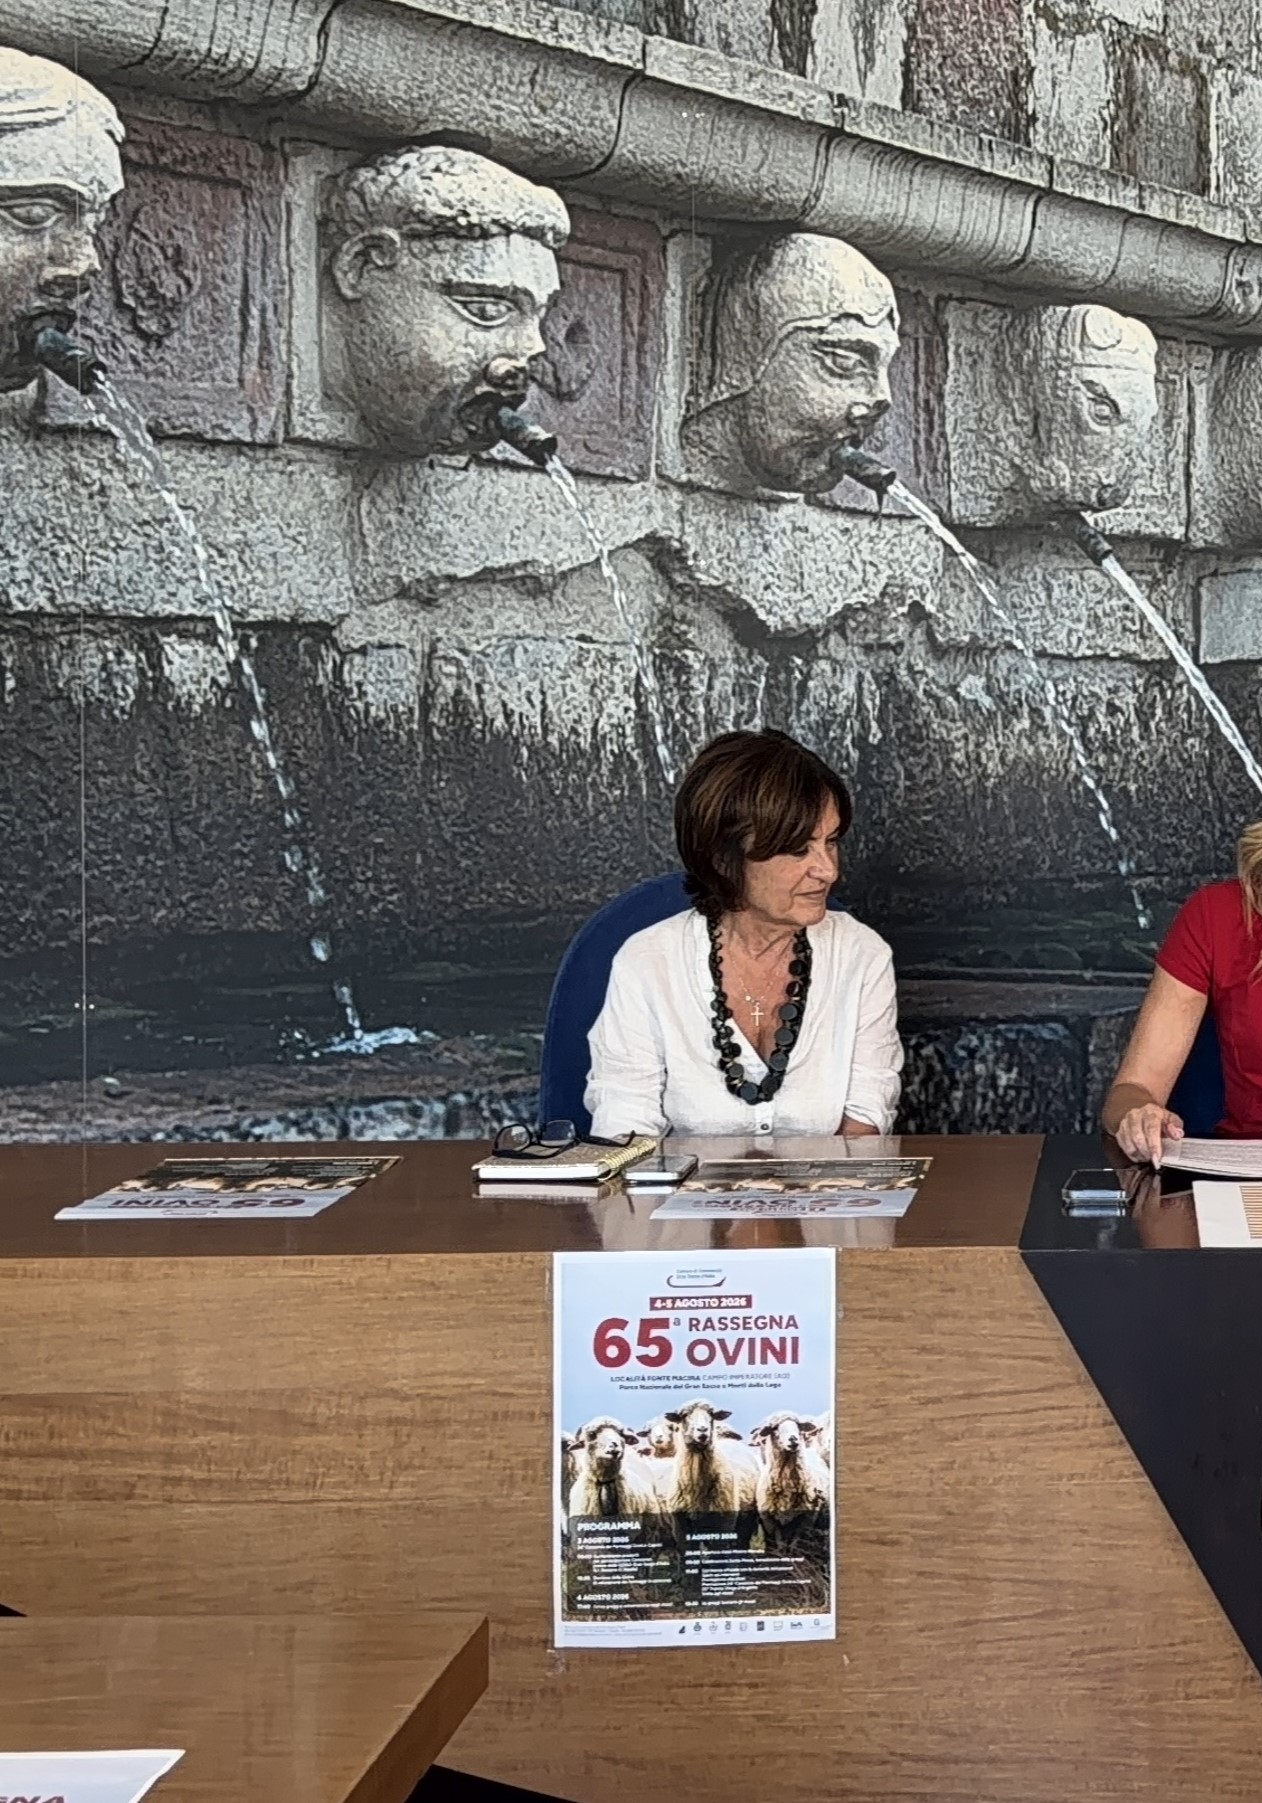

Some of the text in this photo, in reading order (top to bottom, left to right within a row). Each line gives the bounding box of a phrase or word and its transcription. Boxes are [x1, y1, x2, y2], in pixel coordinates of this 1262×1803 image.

[674, 1298, 719, 1308] AGOSTO
[720, 1297, 747, 1307] 2026
[688, 1315, 799, 1332] RASSEGNA
[686, 1336, 799, 1367] OVINI
[577, 1521, 641, 1531] PROGRAMMA
